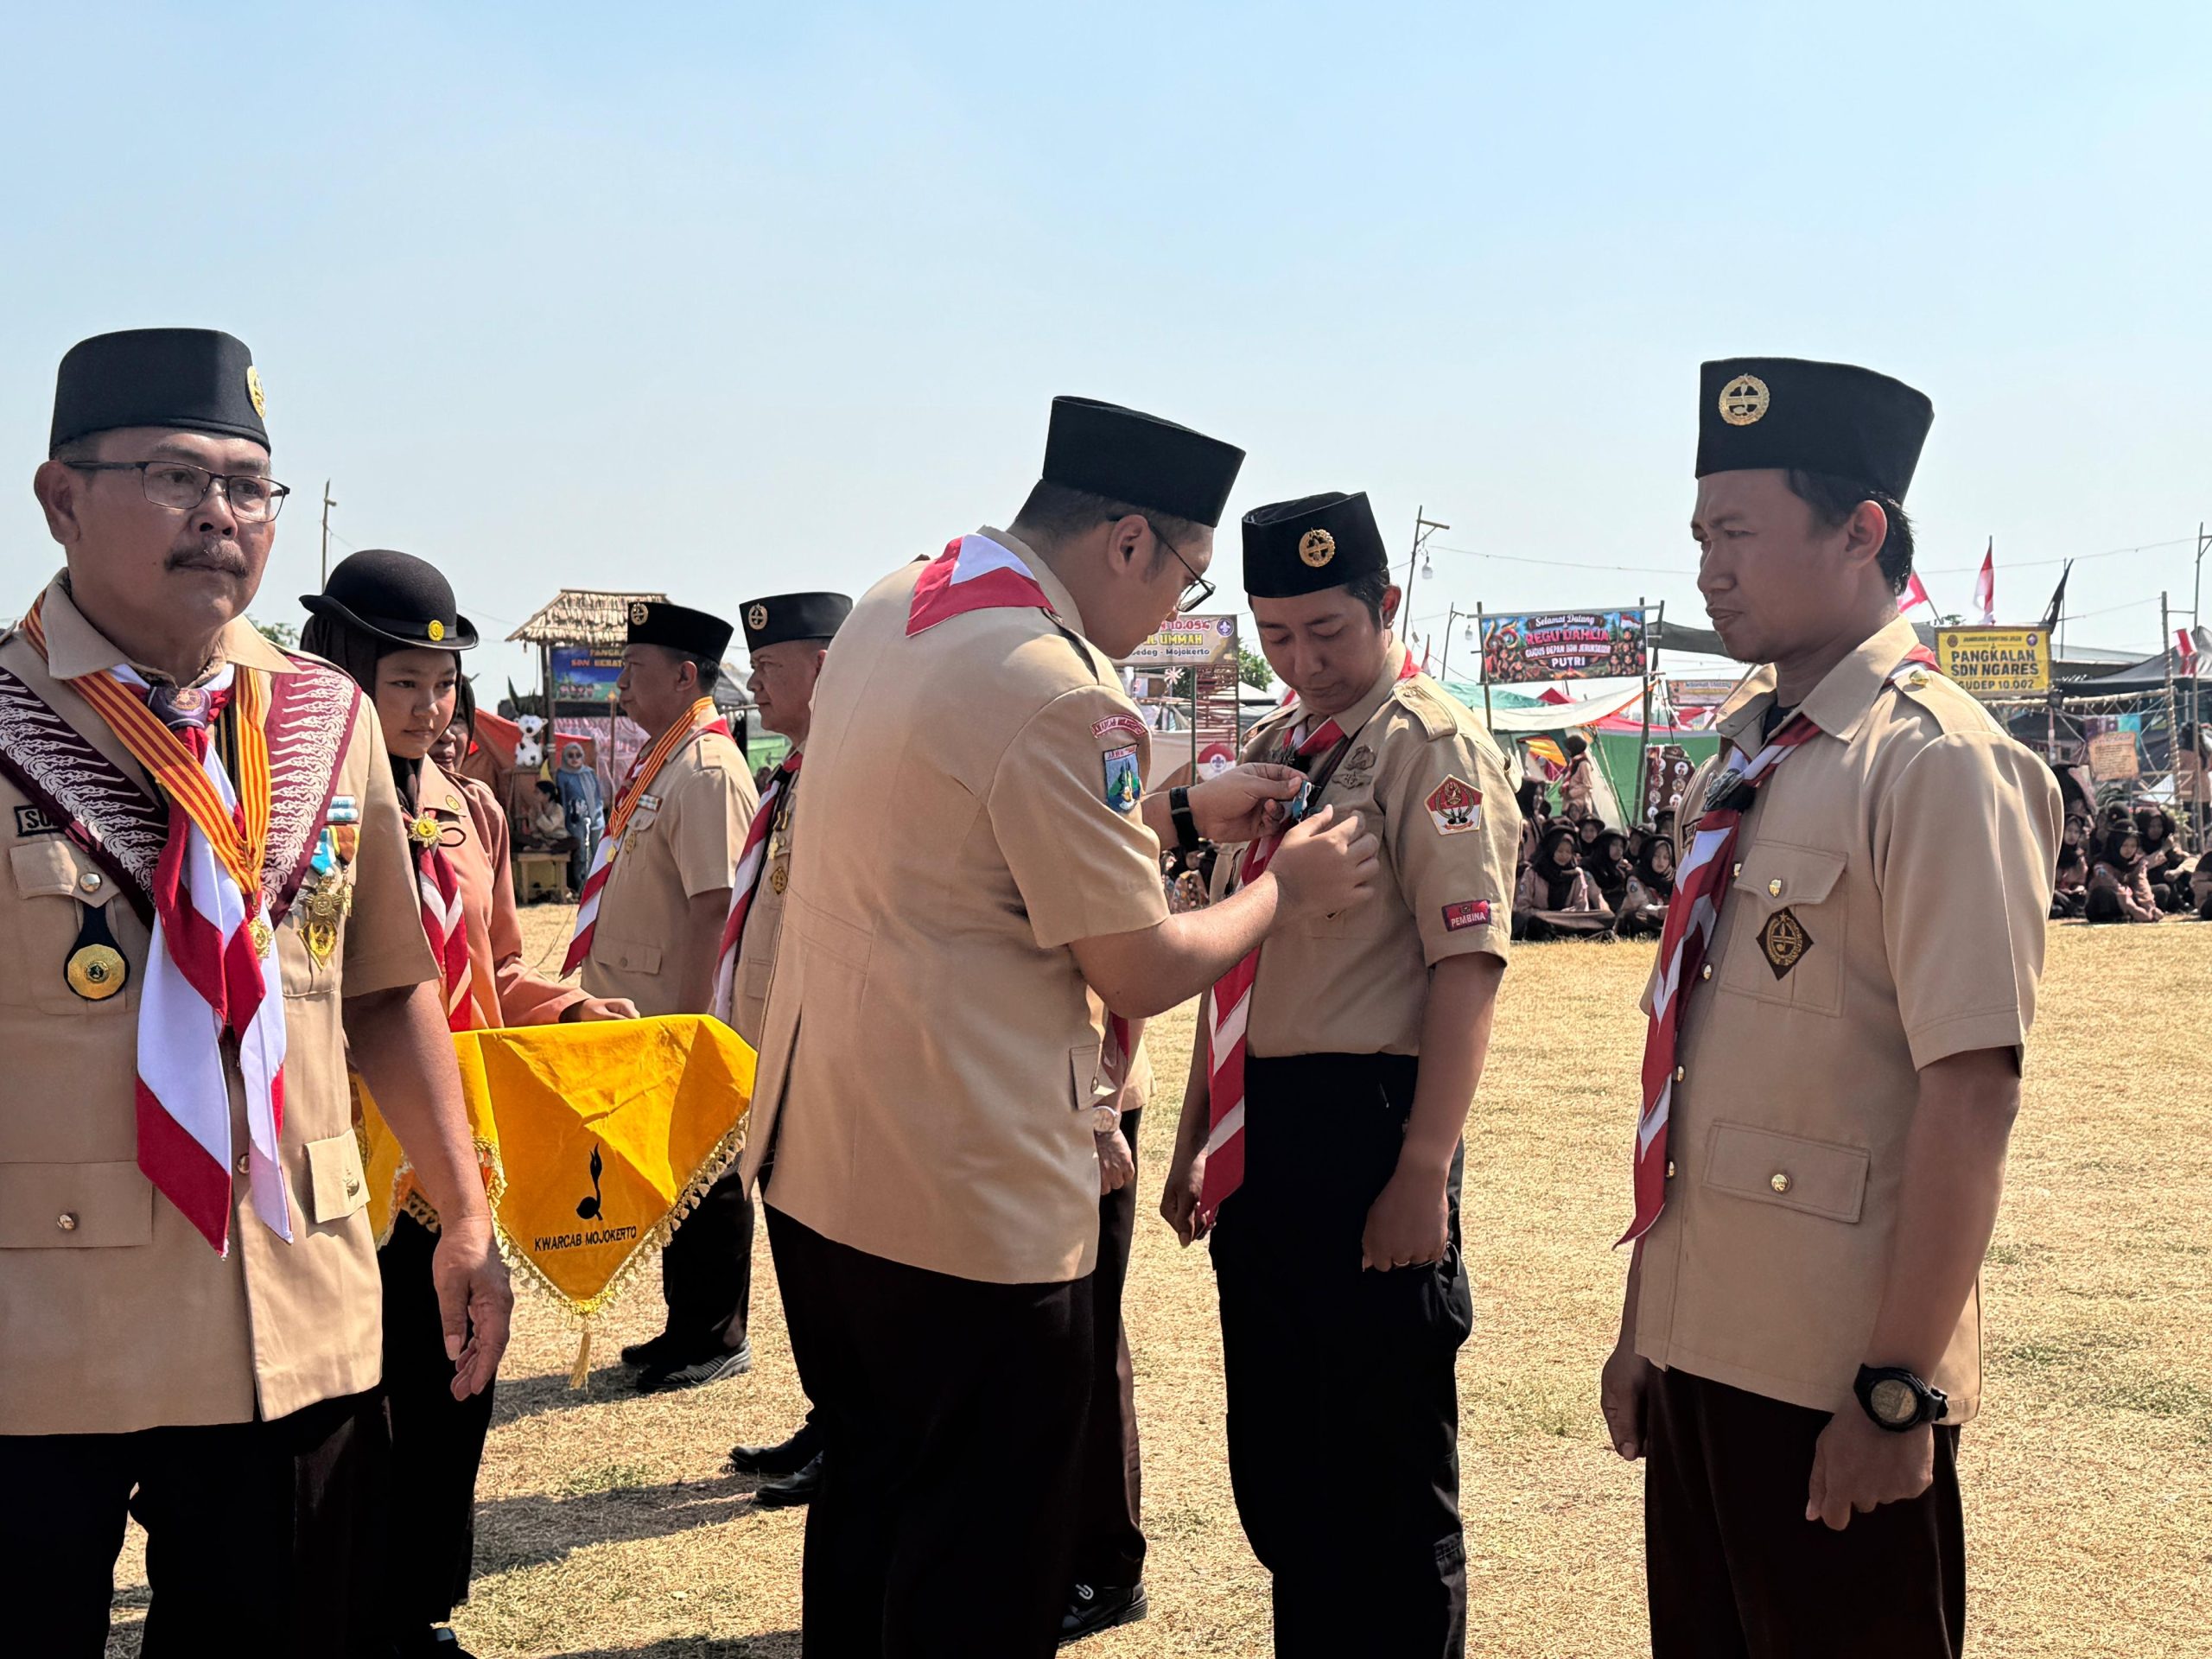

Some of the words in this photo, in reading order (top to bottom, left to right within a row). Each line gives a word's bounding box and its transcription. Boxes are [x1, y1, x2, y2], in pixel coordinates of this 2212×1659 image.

[1535, 615, 1565, 627] Selamat
[1567, 613, 1595, 626] Datang
[1160, 633, 1204, 645] UMMAH
[1525, 630, 1560, 645] REGU
[1562, 628, 1611, 641] DAHLIA
[1552, 656, 1586, 667] PUTRI
[1951, 650, 2036, 662] PANGKALAN
[1951, 664, 1978, 676] SDN
[1982, 663, 2038, 676] NGARES
[1959, 680, 1995, 690] GUDEP
[1999, 679, 2034, 689] 10.002
[1451, 911, 1486, 927] PEMBINA
[534, 1233, 582, 1252] KWARCAB
[585, 1225, 637, 1245] MOJOKERTO
